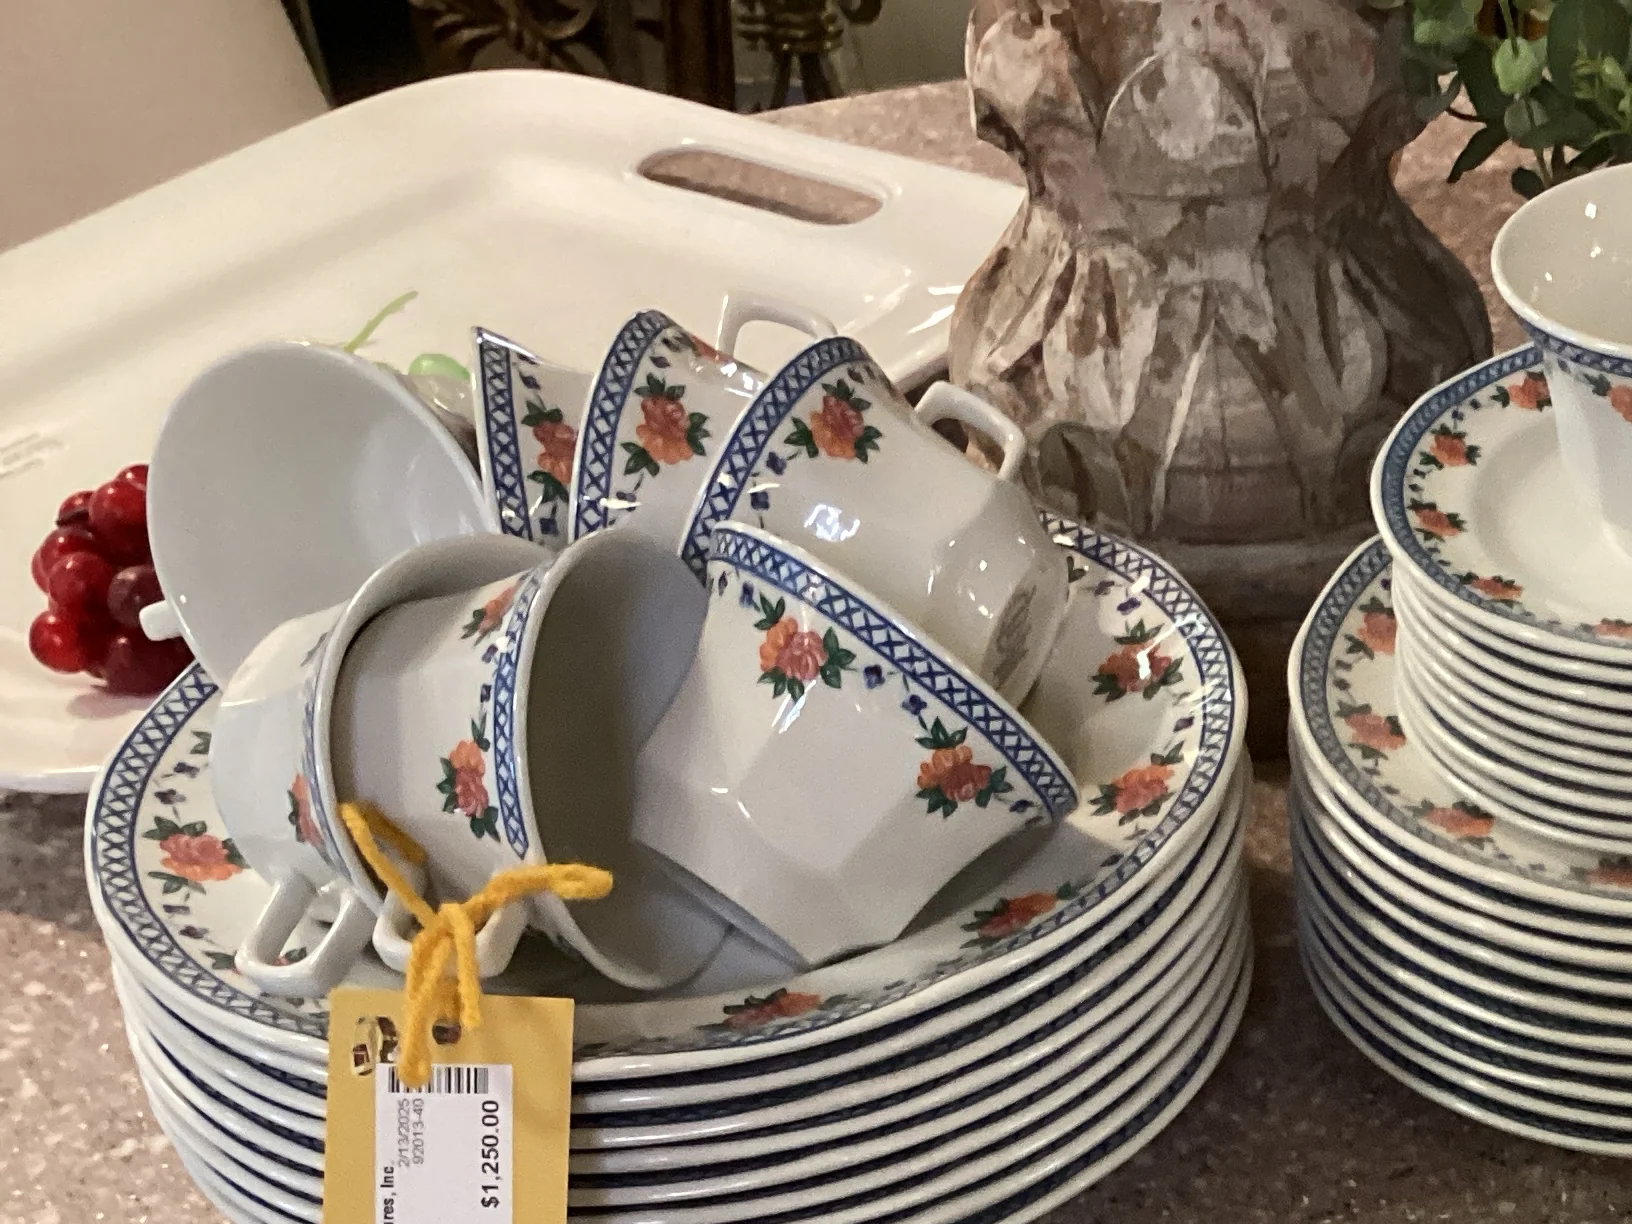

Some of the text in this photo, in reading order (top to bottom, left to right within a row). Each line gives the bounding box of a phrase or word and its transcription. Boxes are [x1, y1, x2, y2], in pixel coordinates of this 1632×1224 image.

[396, 1098, 410, 1168] 2/13/2025
[411, 1098, 425, 1165] 92013-40
[480, 1099, 503, 1209] $1,250.00
[380, 1160, 395, 1189] Inc.
